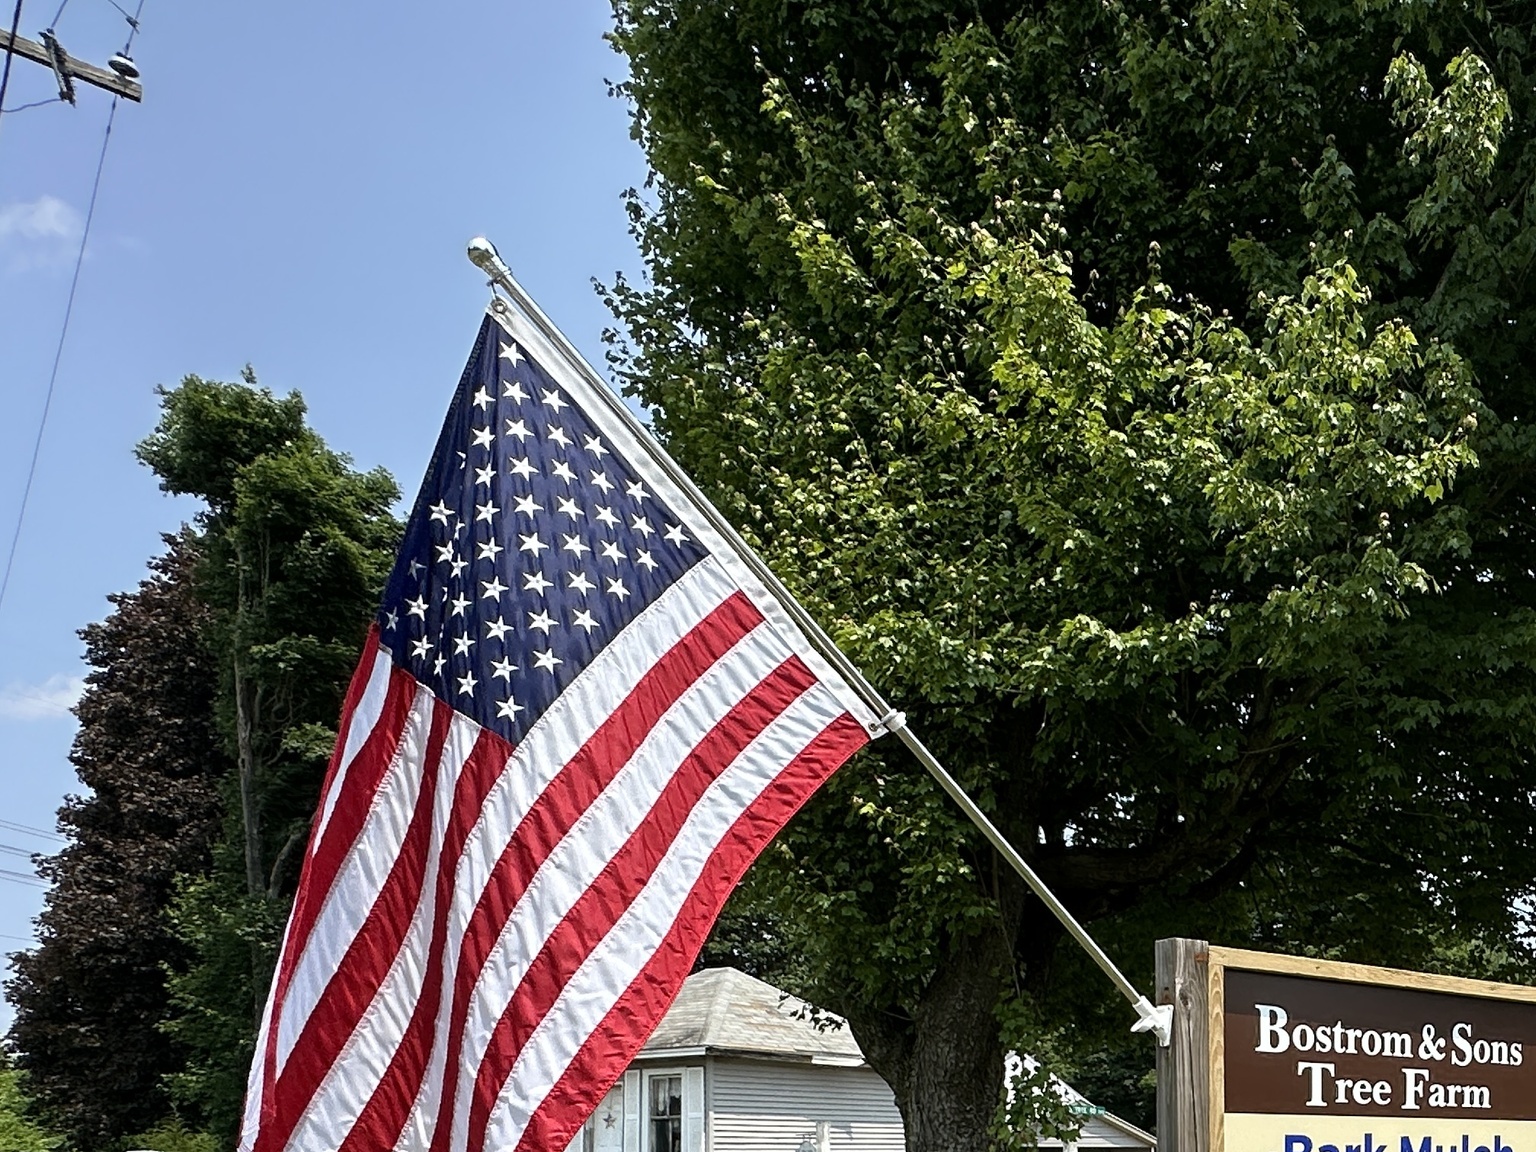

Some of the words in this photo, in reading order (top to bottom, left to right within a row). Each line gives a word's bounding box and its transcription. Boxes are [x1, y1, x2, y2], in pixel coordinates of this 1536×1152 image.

[1255, 1003, 1414, 1058] Bostrom
[1418, 1023, 1447, 1061] &
[1451, 1022, 1524, 1067] Sons
[1297, 1061, 1392, 1107] Tree
[1401, 1068, 1492, 1110] Farm
